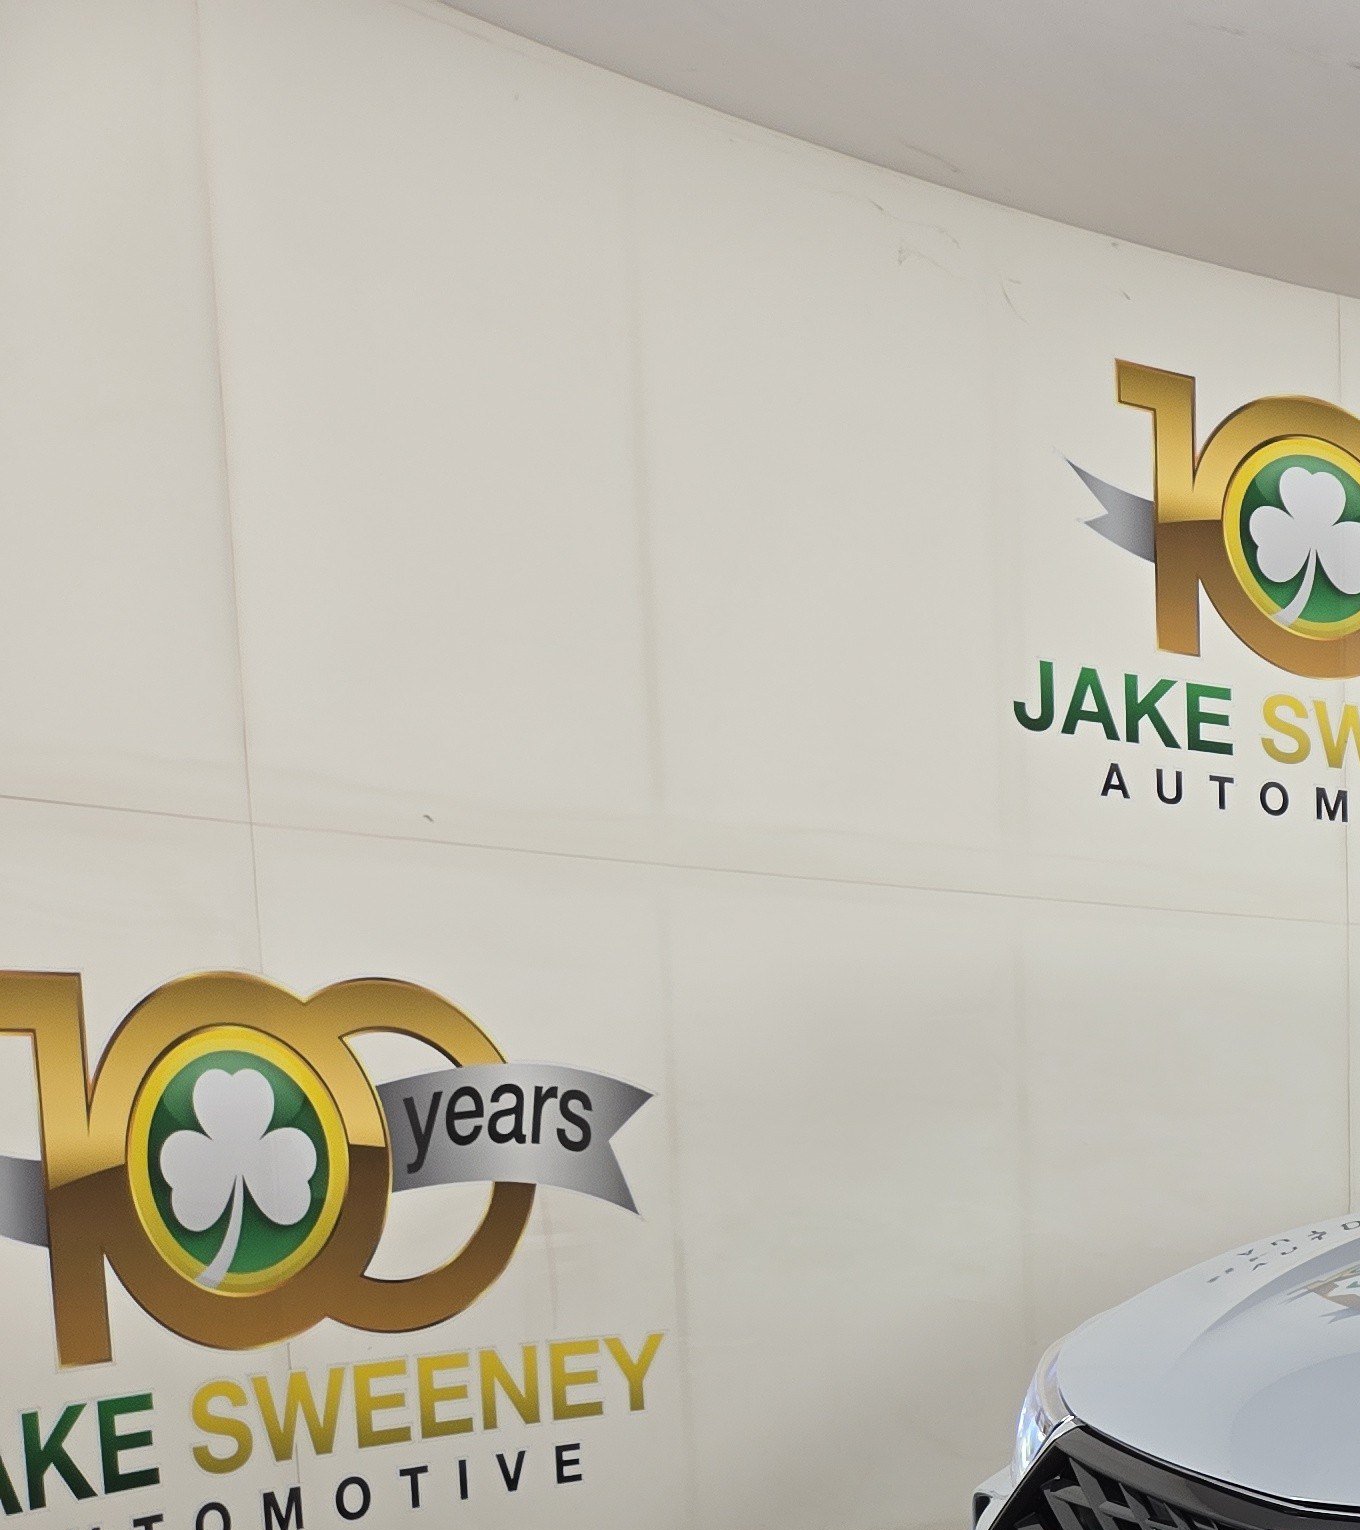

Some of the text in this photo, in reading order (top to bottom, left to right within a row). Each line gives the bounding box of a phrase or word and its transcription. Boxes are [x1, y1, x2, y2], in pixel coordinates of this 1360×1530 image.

[1013, 660, 1233, 756] JAKE
[403, 1081, 594, 1173] years
[191, 1333, 664, 1474] SWEENEY
